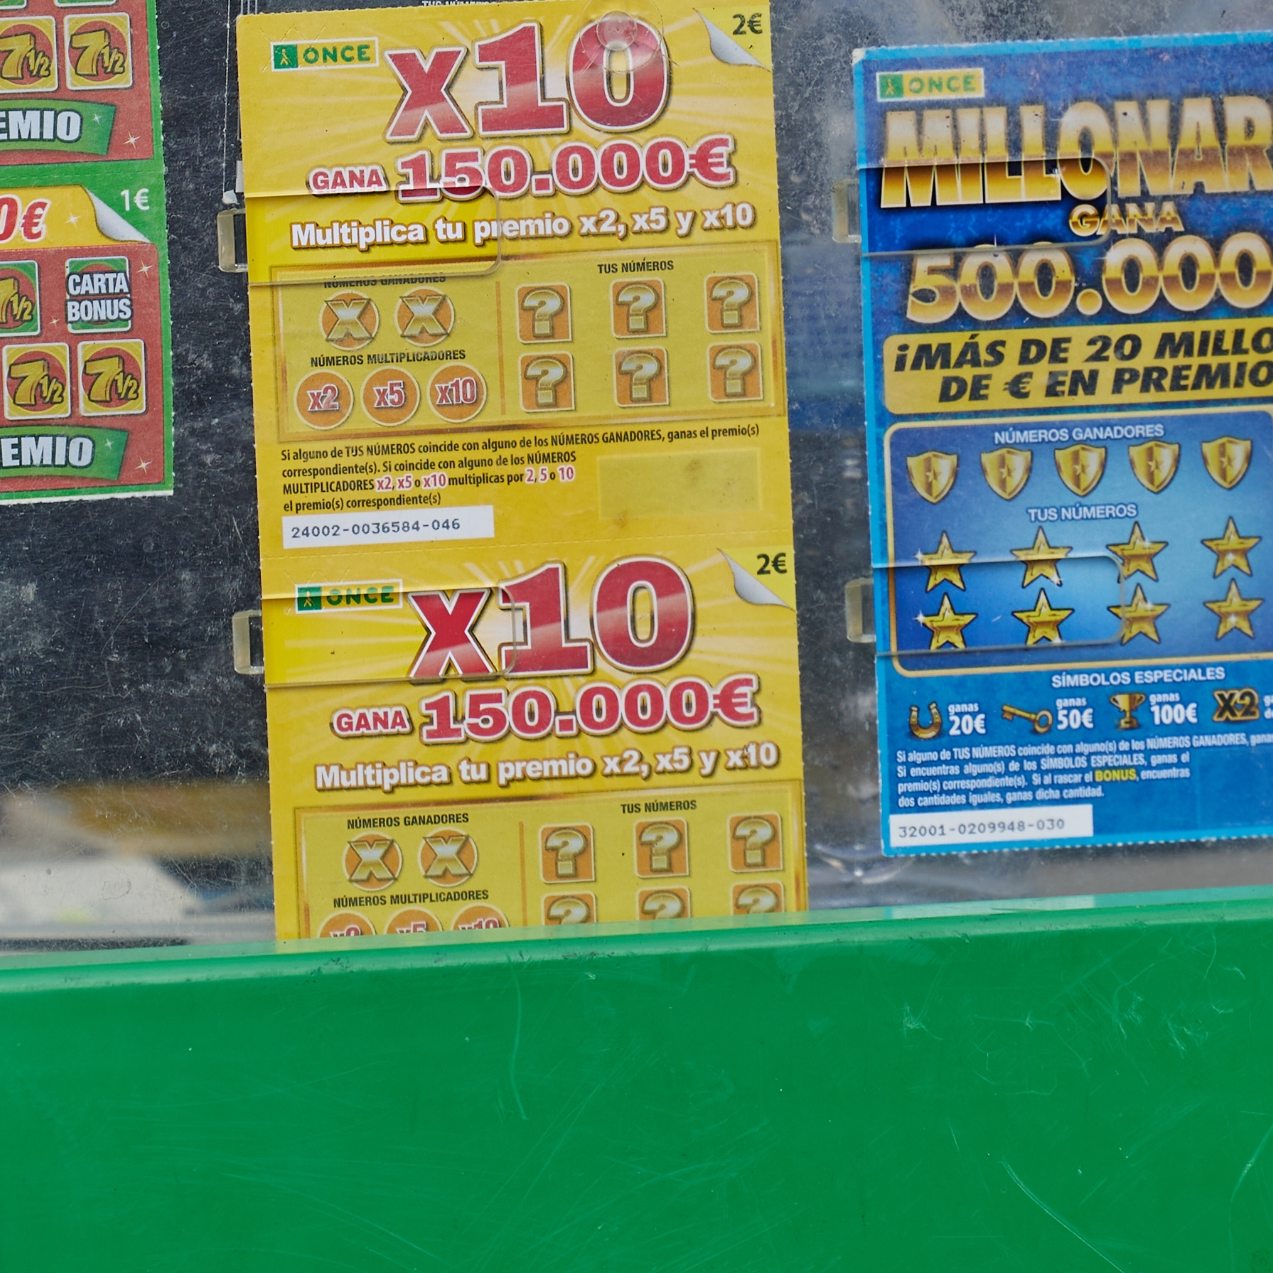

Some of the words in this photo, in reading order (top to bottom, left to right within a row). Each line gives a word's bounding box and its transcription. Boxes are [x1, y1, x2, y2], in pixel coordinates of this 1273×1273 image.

[733, 14, 763, 36] 2€
[303, 44, 370, 63] ONCE
[908, 74, 976, 95] ONCE
[310, 166, 386, 194] GANA
[397, 136, 736, 203] 150.000€
[121, 188, 149, 211] 1€
[292, 219, 425, 250] Multiplica
[436, 220, 464, 241] tu
[474, 216, 569, 245] premio
[579, 210, 626, 238] x2,
[632, 207, 666, 231] x5
[676, 213, 691, 234] y
[703, 204, 754, 228] x10
[1069, 201, 1184, 237] GANA
[598, 262, 618, 274] TUS
[622, 259, 674, 273] NÚMEROS
[311, 351, 363, 367] NÚMEROS
[366, 349, 466, 365] MULTIPLICADORES
[1019, 338, 1073, 366] DE
[1087, 333, 1141, 363] 20
[307, 385, 339, 412] x2
[373, 380, 406, 408] x5
[435, 377, 477, 406] x10
[938, 375, 989, 403] DE
[1003, 371, 1032, 399] €
[1045, 367, 1097, 398] EN
[284, 501, 292, 512] el
[295, 496, 344, 514] premio(s)
[346, 492, 441, 511] correspondiente(s)
[291, 518, 461, 539] 24002-0036584-046
[757, 553, 788, 575] 2€
[327, 585, 394, 606] ONCE
[1051, 669, 1130, 690] SÍMBOLOS
[1134, 666, 1225, 684] ESPECIALES
[333, 708, 410, 735] GANA
[421, 673, 760, 742] 150.000€
[948, 702, 980, 716] ganas
[1056, 697, 1086, 711] ganas
[1150, 692, 1180, 705] ganas
[948, 714, 986, 736] 20€
[1057, 708, 1094, 731] 50€
[1150, 704, 1198, 726] 100€
[315, 761, 450, 793] Multiplica
[459, 762, 488, 784] tu
[498, 757, 594, 787] premio
[603, 750, 648, 778] x2,
[656, 747, 691, 772] x5
[699, 753, 718, 776] y
[727, 743, 778, 769] x10
[898, 818, 1066, 839] 32001-0209948-030
